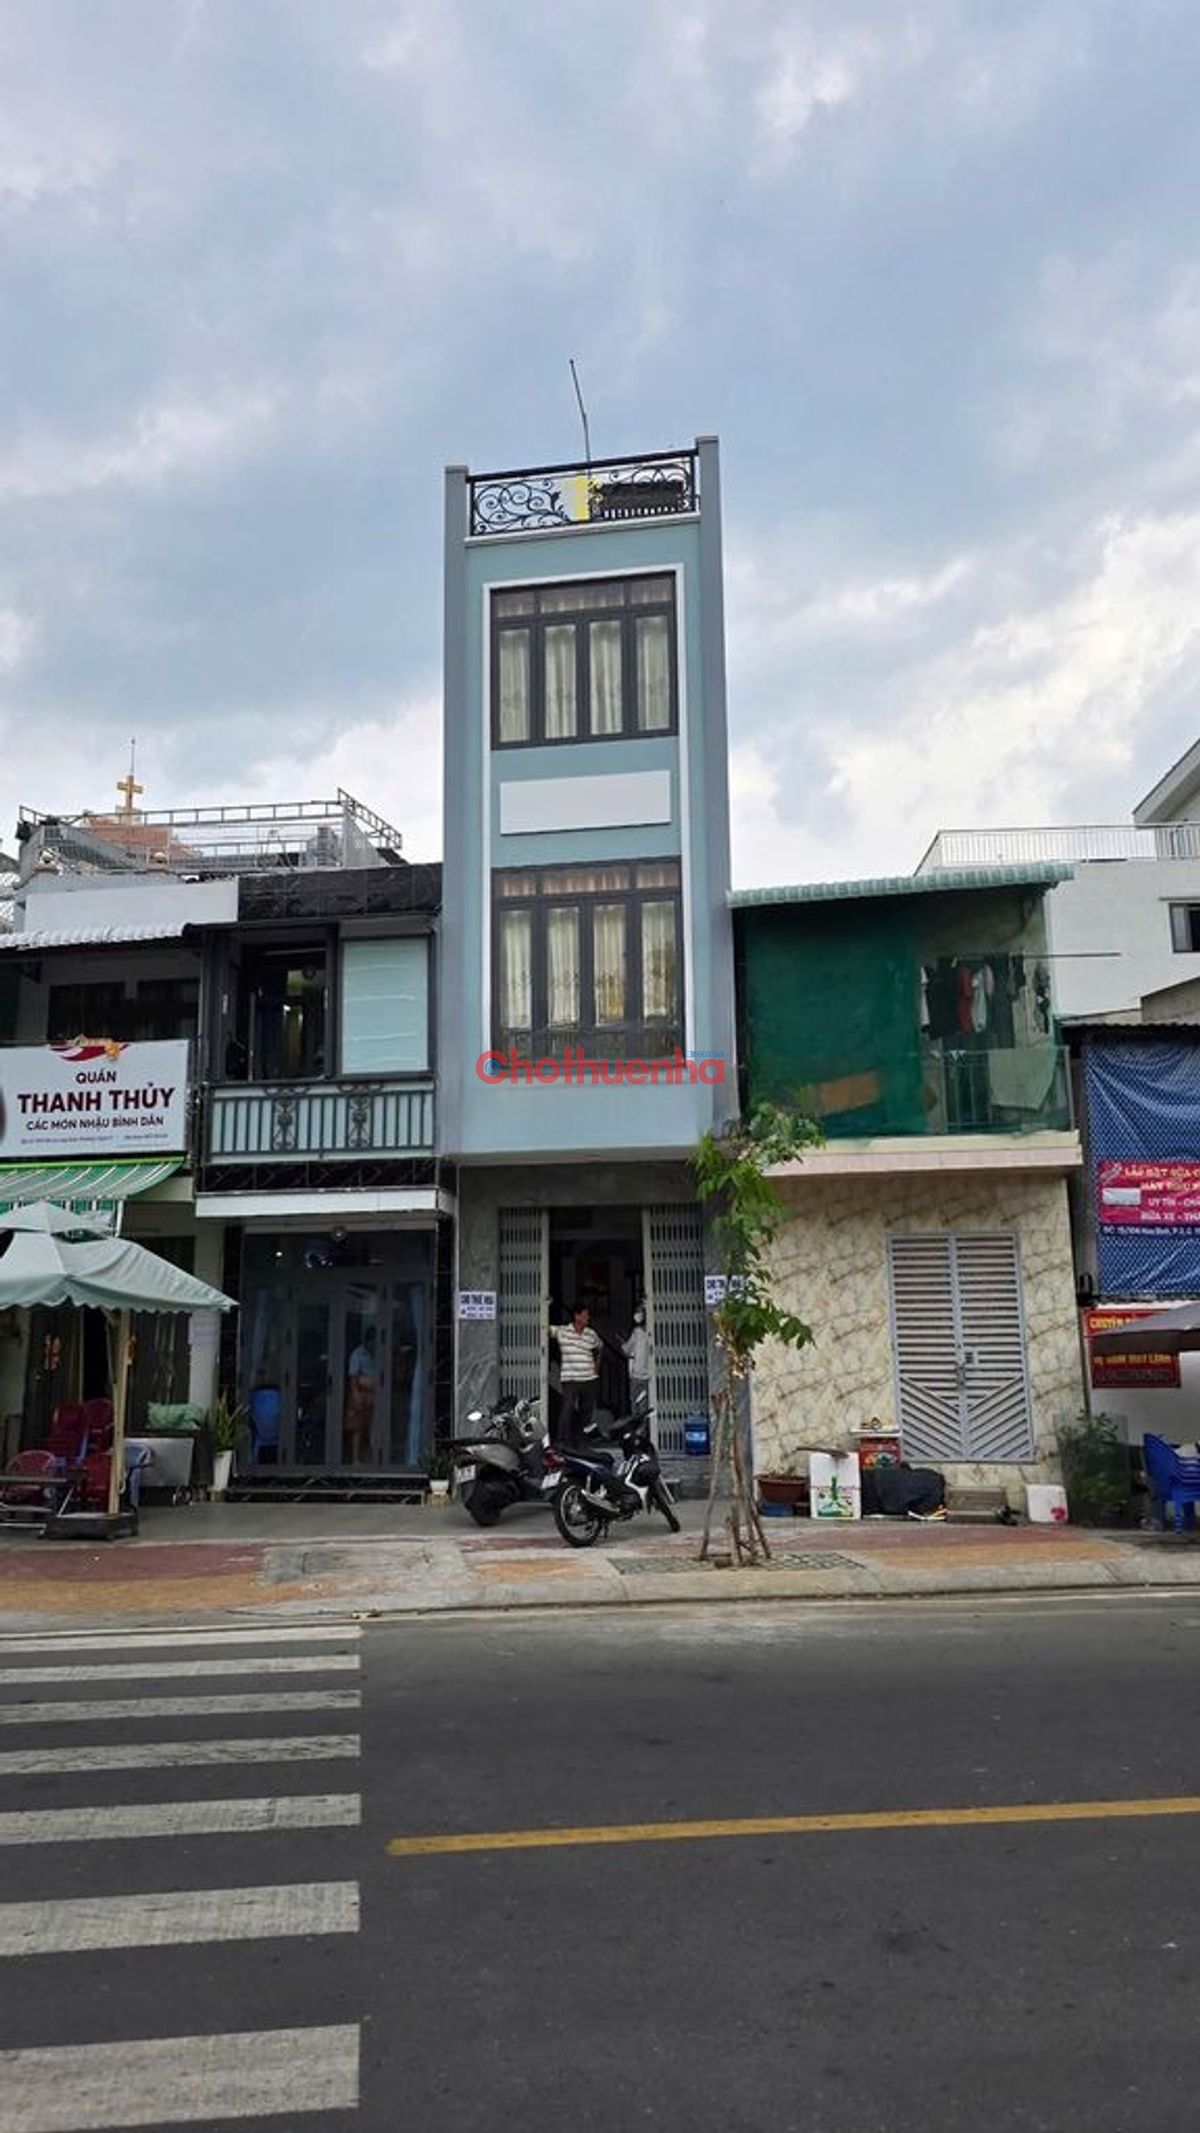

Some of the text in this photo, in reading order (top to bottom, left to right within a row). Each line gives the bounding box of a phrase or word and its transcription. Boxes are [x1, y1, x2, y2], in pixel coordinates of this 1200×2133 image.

[75, 1068, 117, 1084] QUÁN
[17, 1082, 176, 1114] THANH THỦY
[26, 1114, 164, 1132] CÁC MÓN NHẬU BÌNH DÂN
